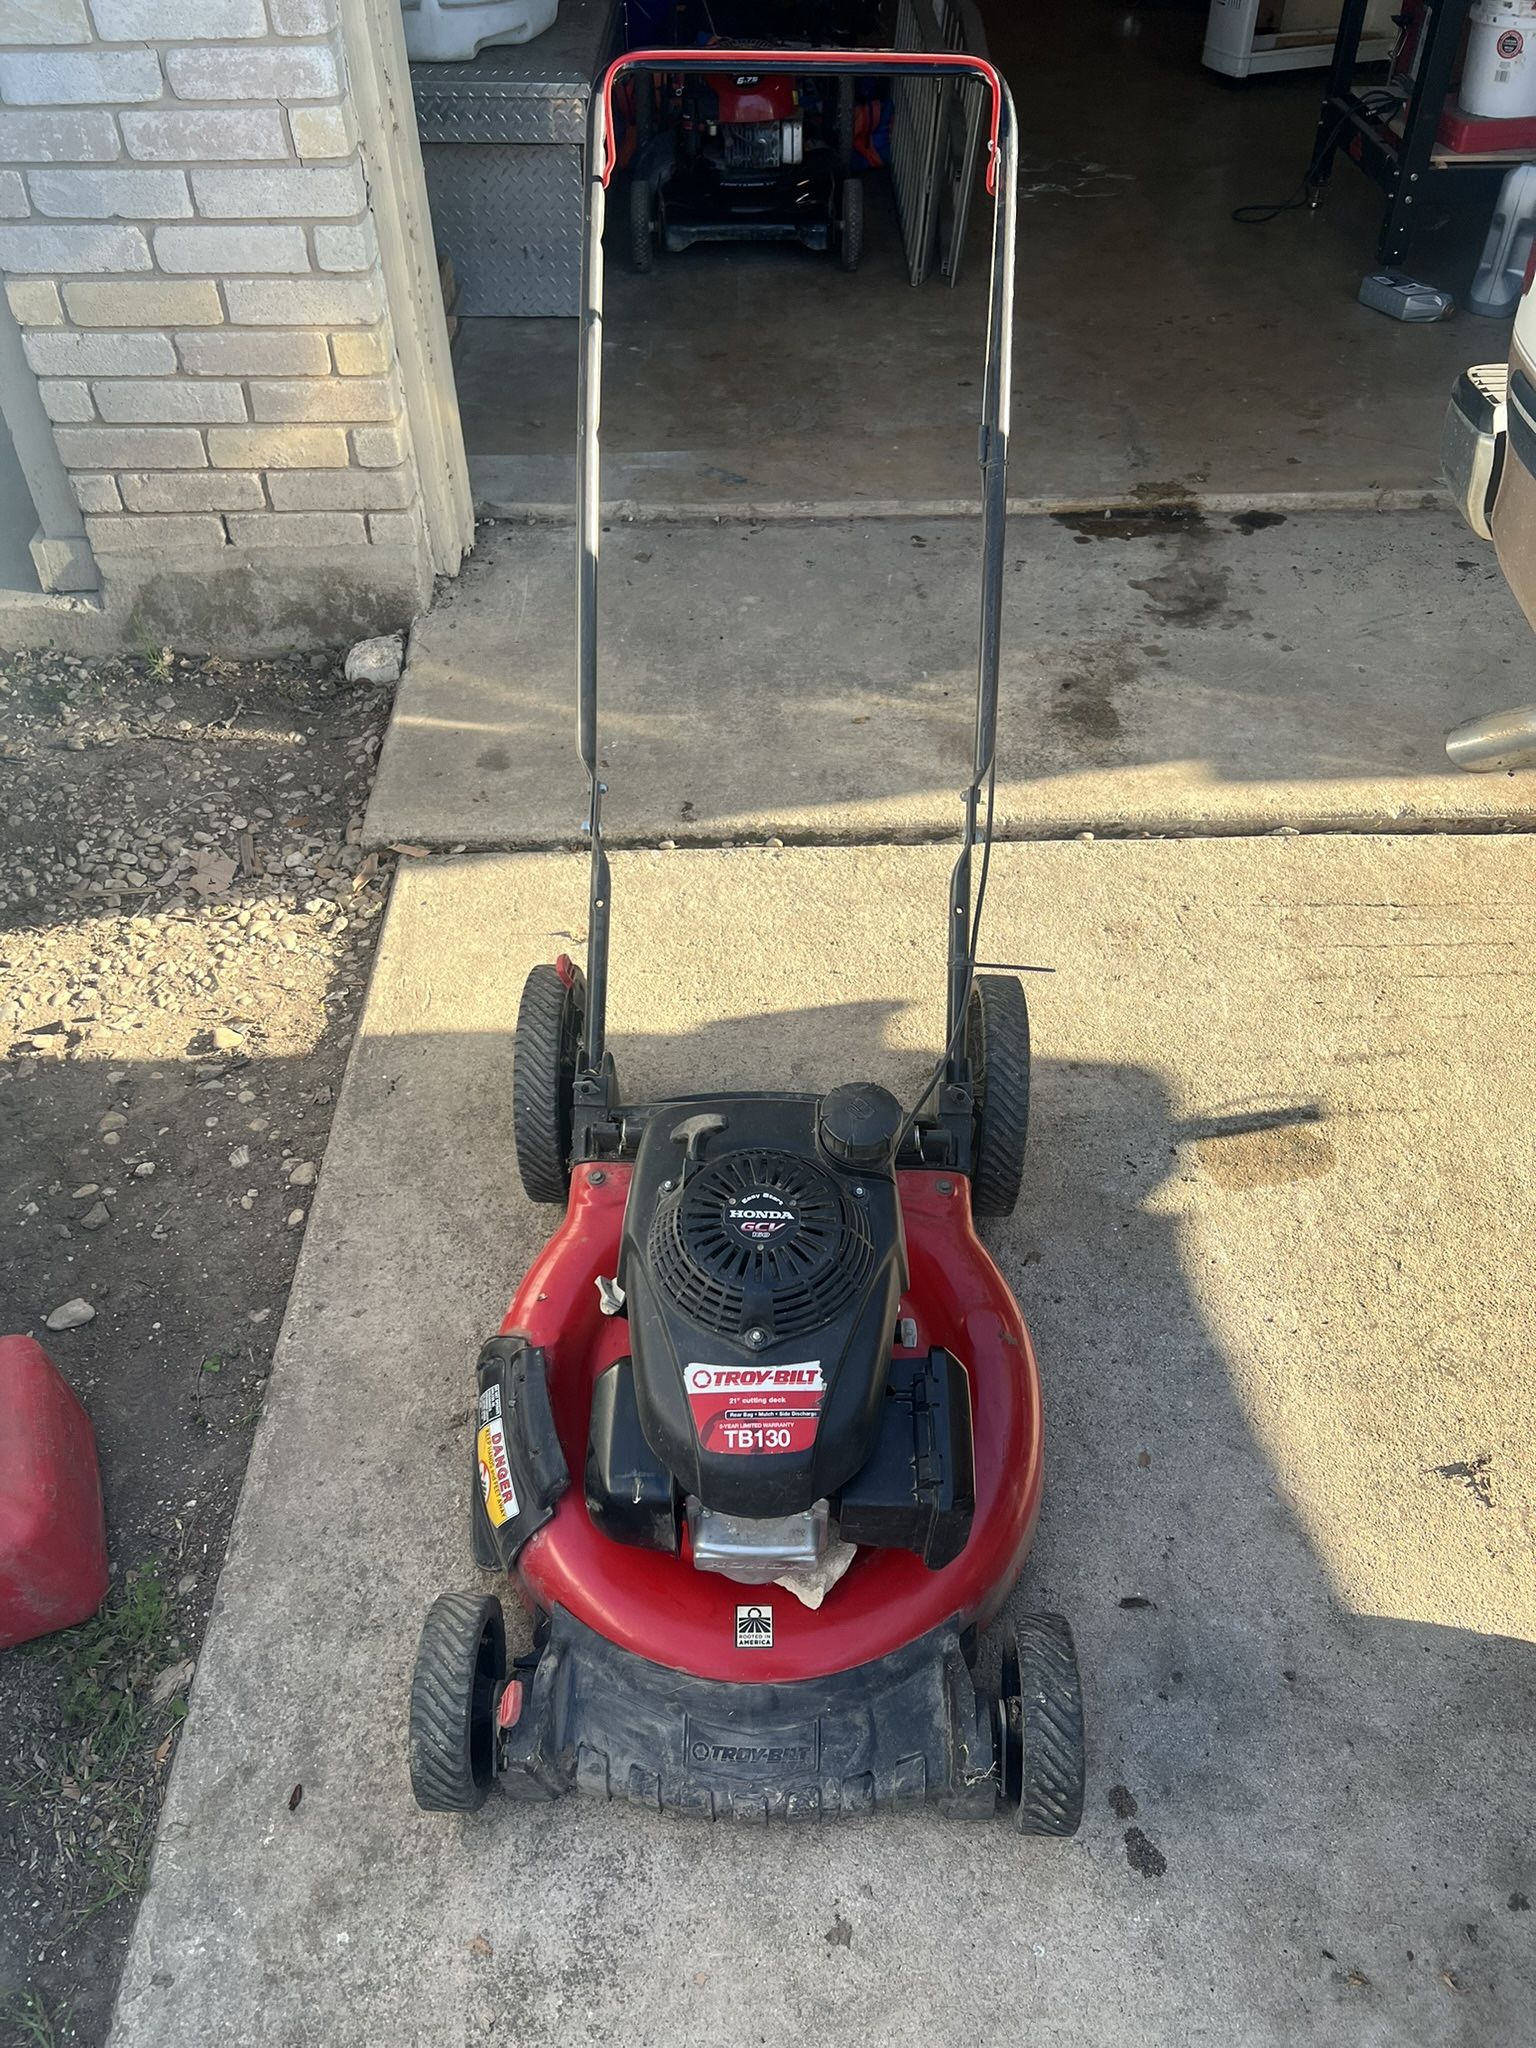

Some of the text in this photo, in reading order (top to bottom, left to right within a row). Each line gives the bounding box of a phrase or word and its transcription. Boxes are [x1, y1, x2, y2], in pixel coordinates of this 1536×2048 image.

[741, 1193, 784, 1206] Easy Start
[729, 1209, 795, 1220] HONDA
[740, 1221, 786, 1232] GCV
[713, 1370, 819, 1386] TROY-BILT
[742, 1397, 767, 1405] cutting
[724, 1429, 791, 1448] TB130
[491, 1432, 513, 1504] DANGER
[496, 1498, 506, 1518] AWAY
[710, 1745, 812, 1764] TROY-BILT
